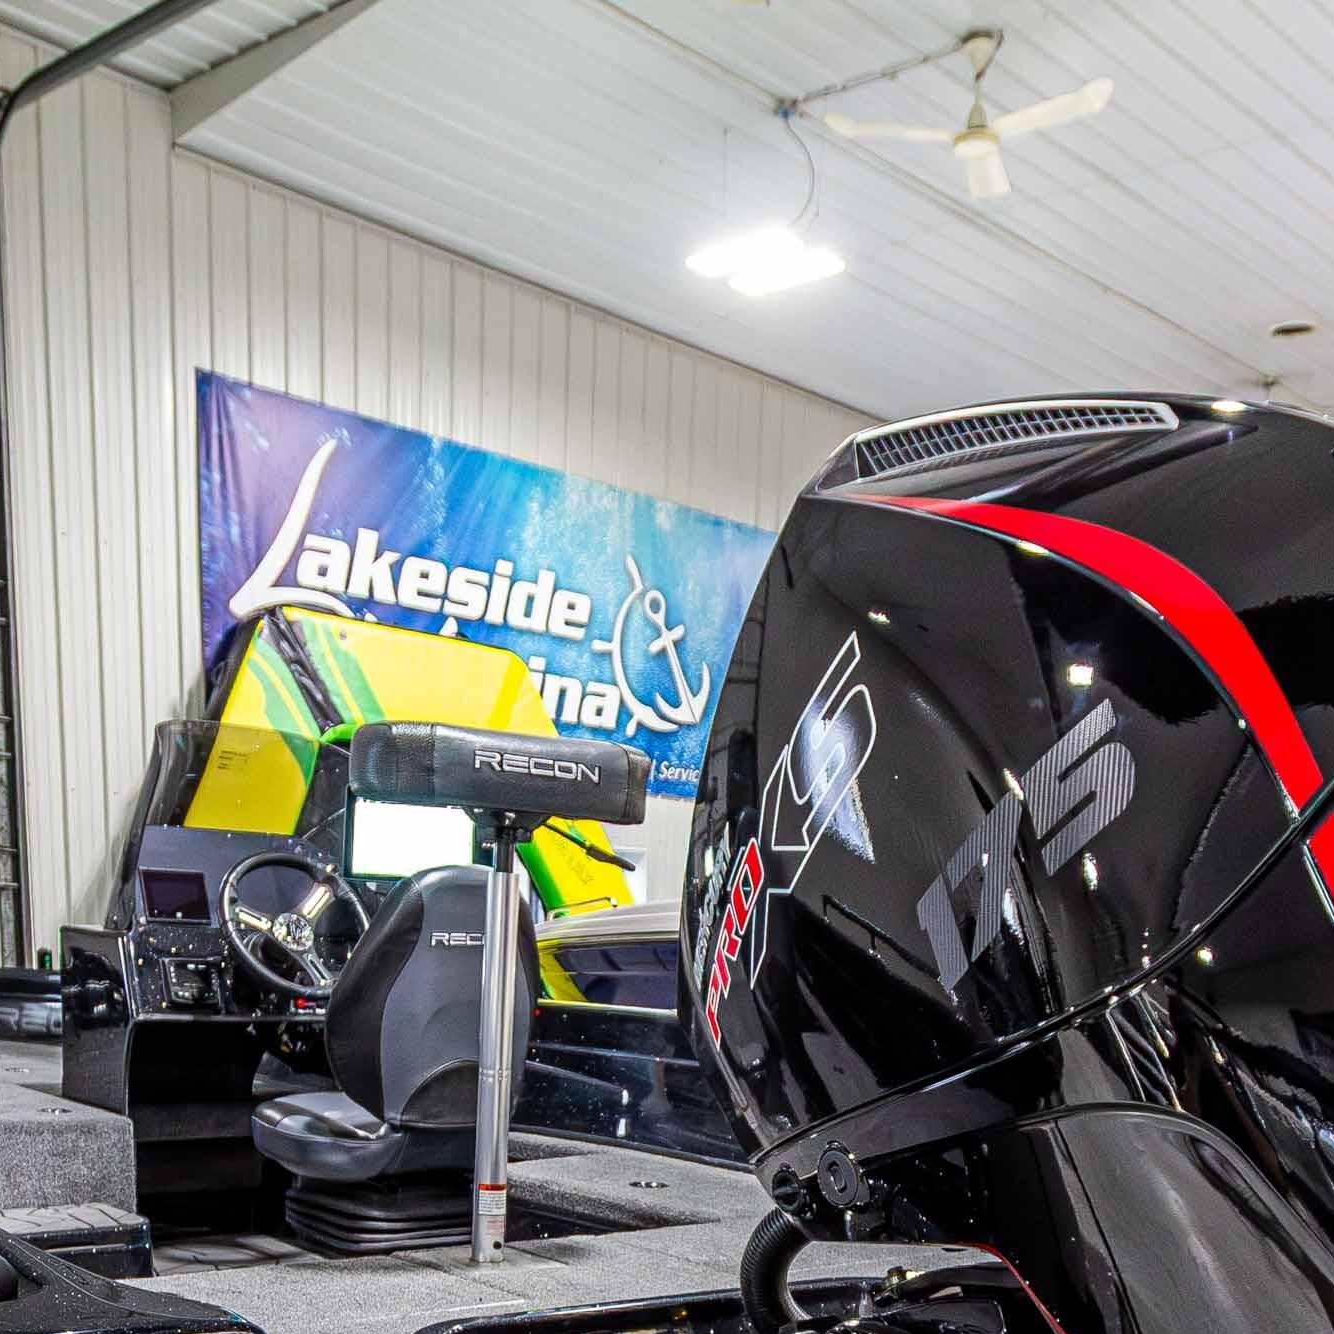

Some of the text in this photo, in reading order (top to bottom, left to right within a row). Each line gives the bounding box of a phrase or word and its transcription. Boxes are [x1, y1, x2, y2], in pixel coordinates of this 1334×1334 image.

[227, 437, 592, 641] Lakeside
[474, 749, 601, 784] RECON
[658, 760, 700, 783] Servic
[915, 697, 1138, 996] 175
[430, 932, 485, 948] REC
[704, 836, 766, 1052] PRO
